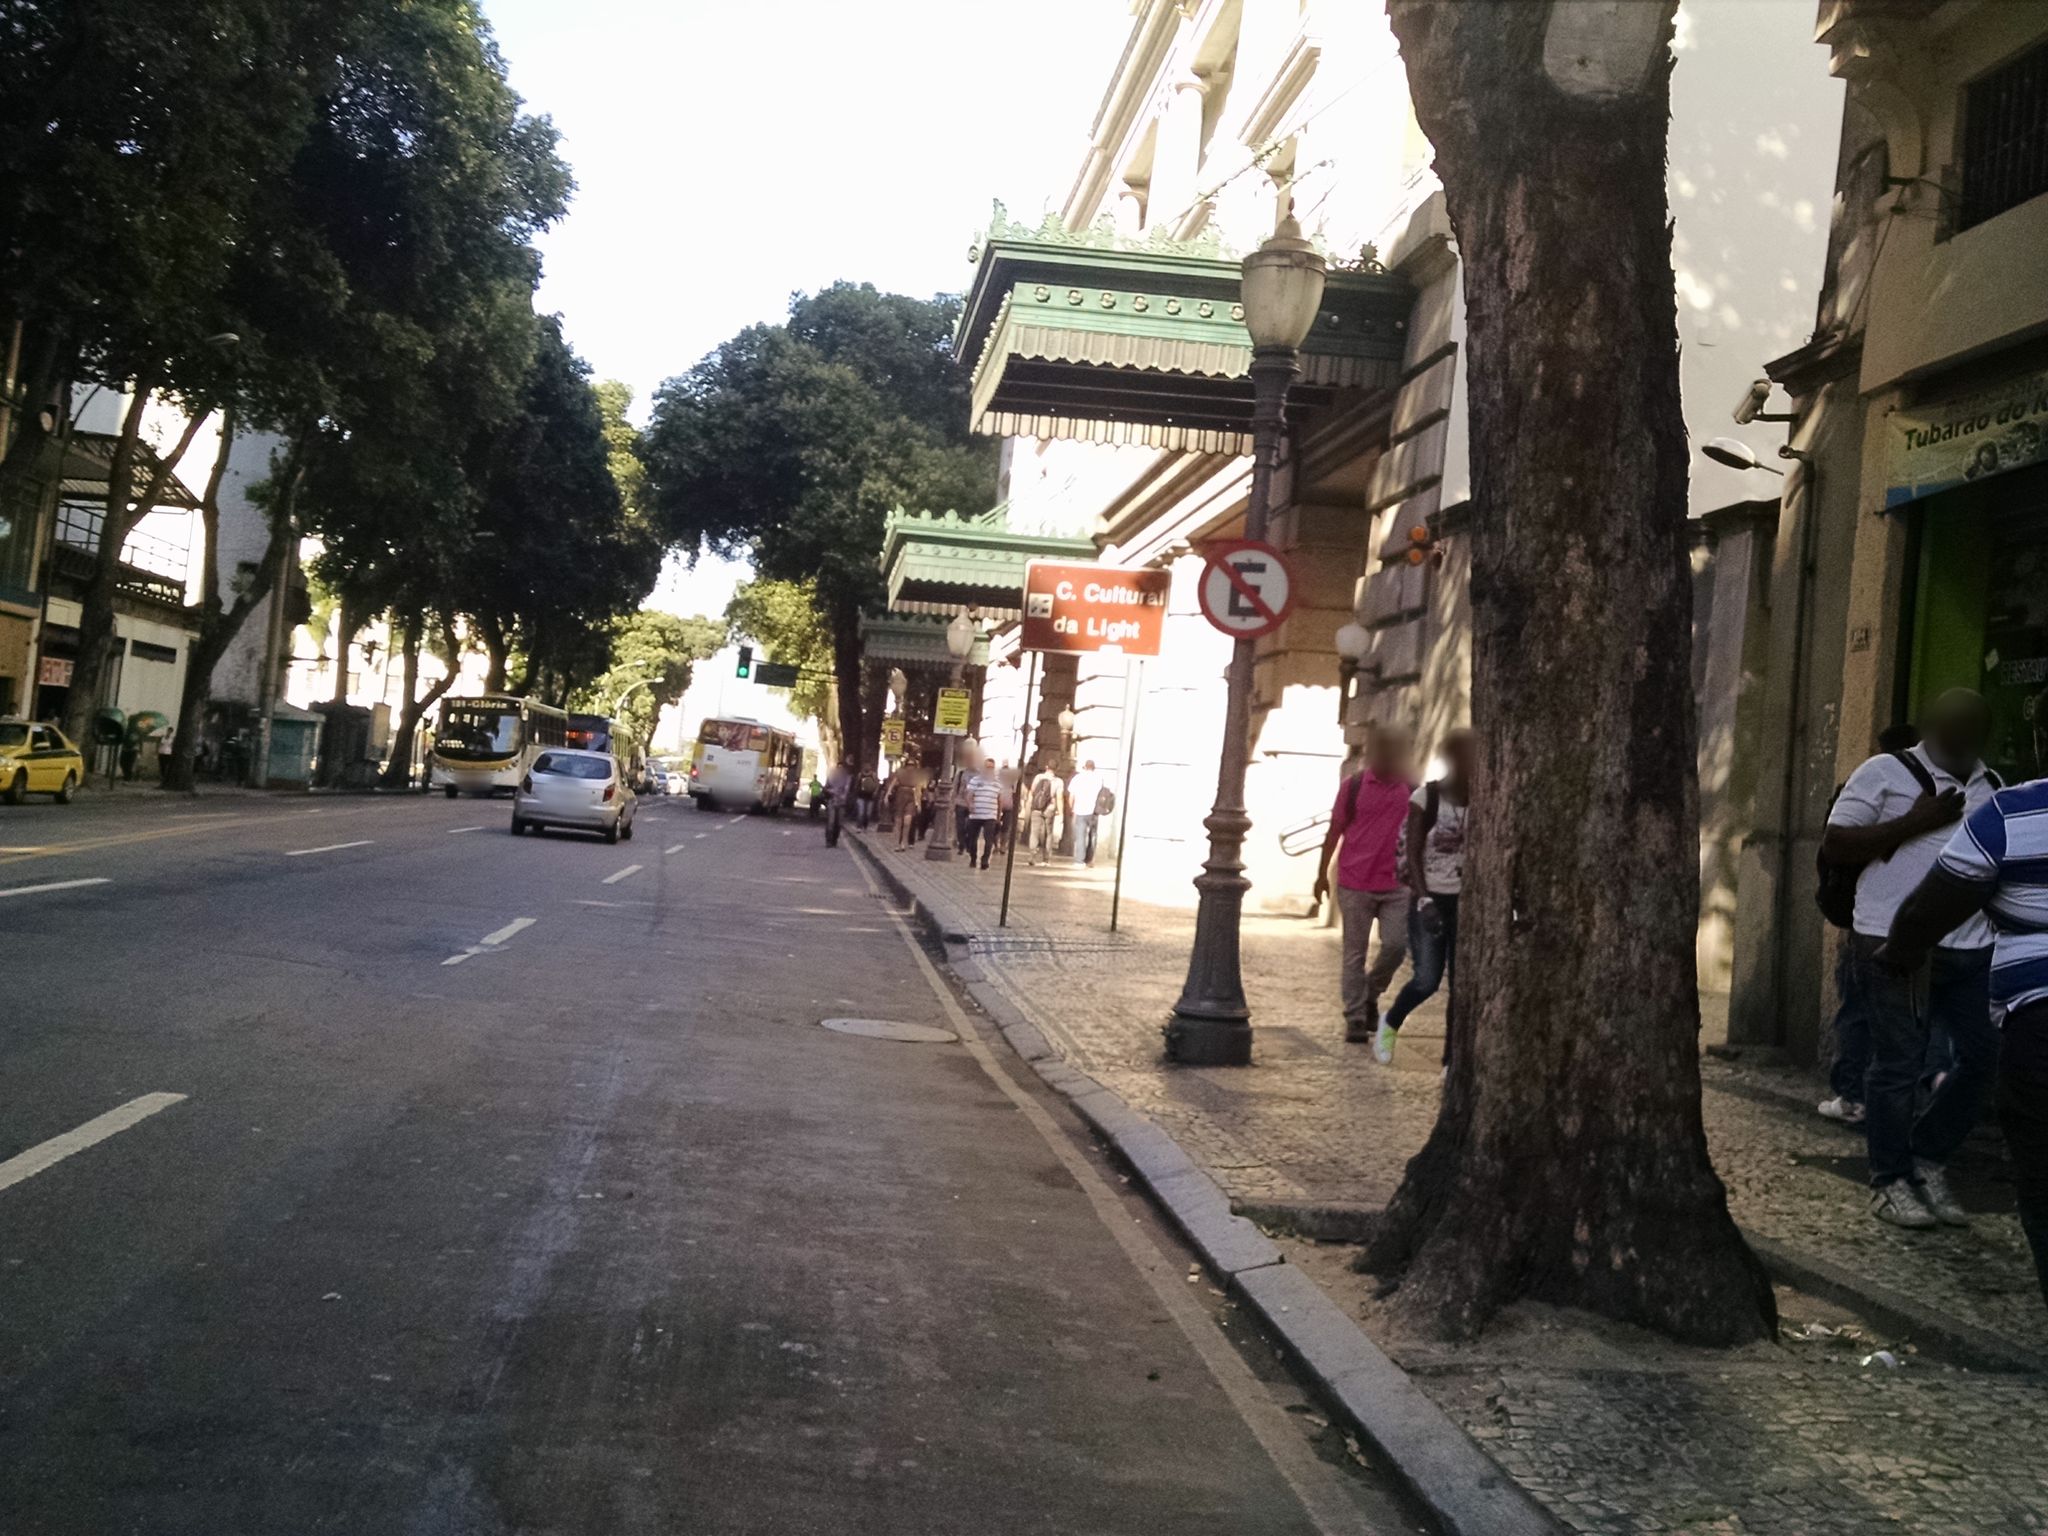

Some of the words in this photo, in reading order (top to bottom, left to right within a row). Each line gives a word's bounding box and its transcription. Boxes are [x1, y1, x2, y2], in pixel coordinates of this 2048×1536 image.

[1996, 401, 2027, 425] do
[1056, 581, 1077, 600] C.
[1084, 582, 1164, 606] Cultural
[1228, 561, 1266, 617] E
[1053, 615, 1079, 634] da
[1086, 617, 1141, 641] Light
